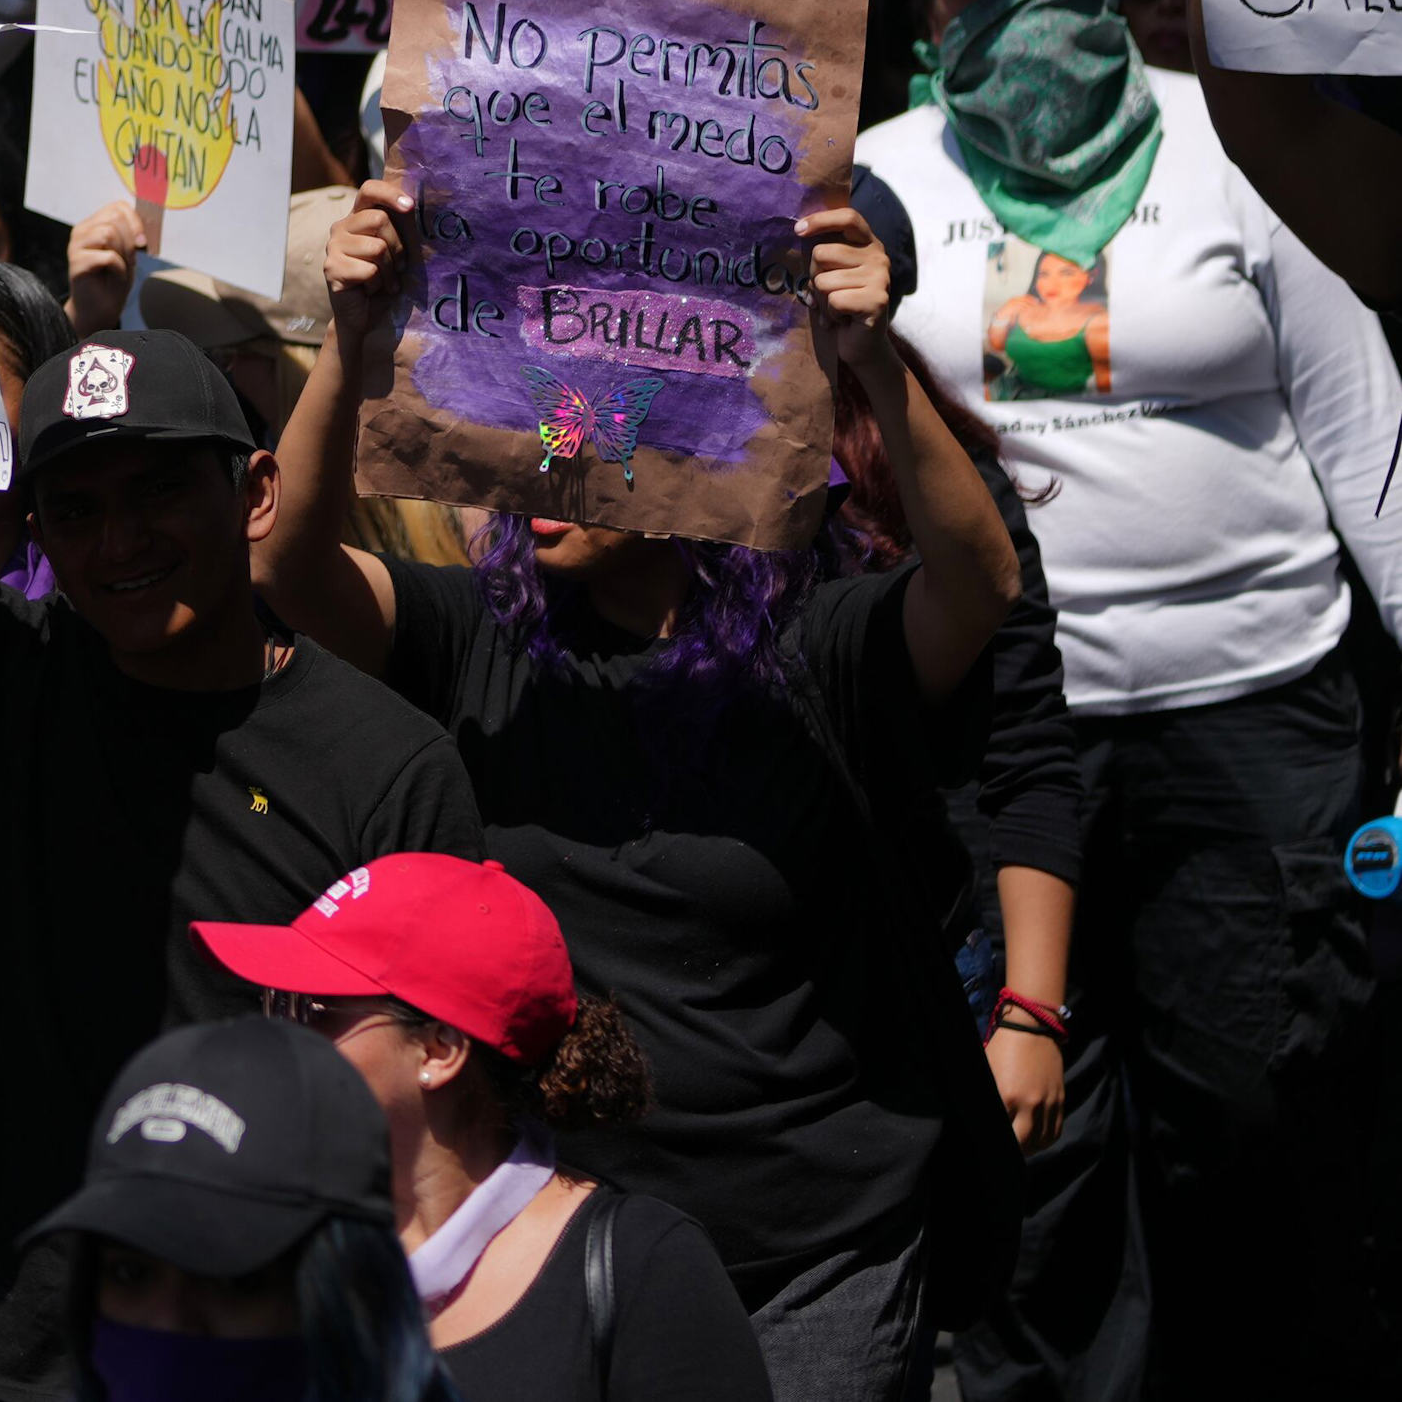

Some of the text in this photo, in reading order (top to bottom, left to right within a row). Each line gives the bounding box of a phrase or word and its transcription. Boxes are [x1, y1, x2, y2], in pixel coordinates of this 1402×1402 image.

[98, 16, 268, 100] CUANDO TODO
[186, 4, 215, 51] EN
[222, 17, 285, 74] CALMA
[576, 20, 820, 112] permitas
[73, 56, 263, 153] EL AÑO NOS LA
[442, 84, 554, 158] que
[580, 78, 628, 137] el
[114, 116, 208, 193] QUITAN
[483, 138, 719, 230] te robe
[414, 181, 474, 243] la
[432, 275, 506, 339] de
